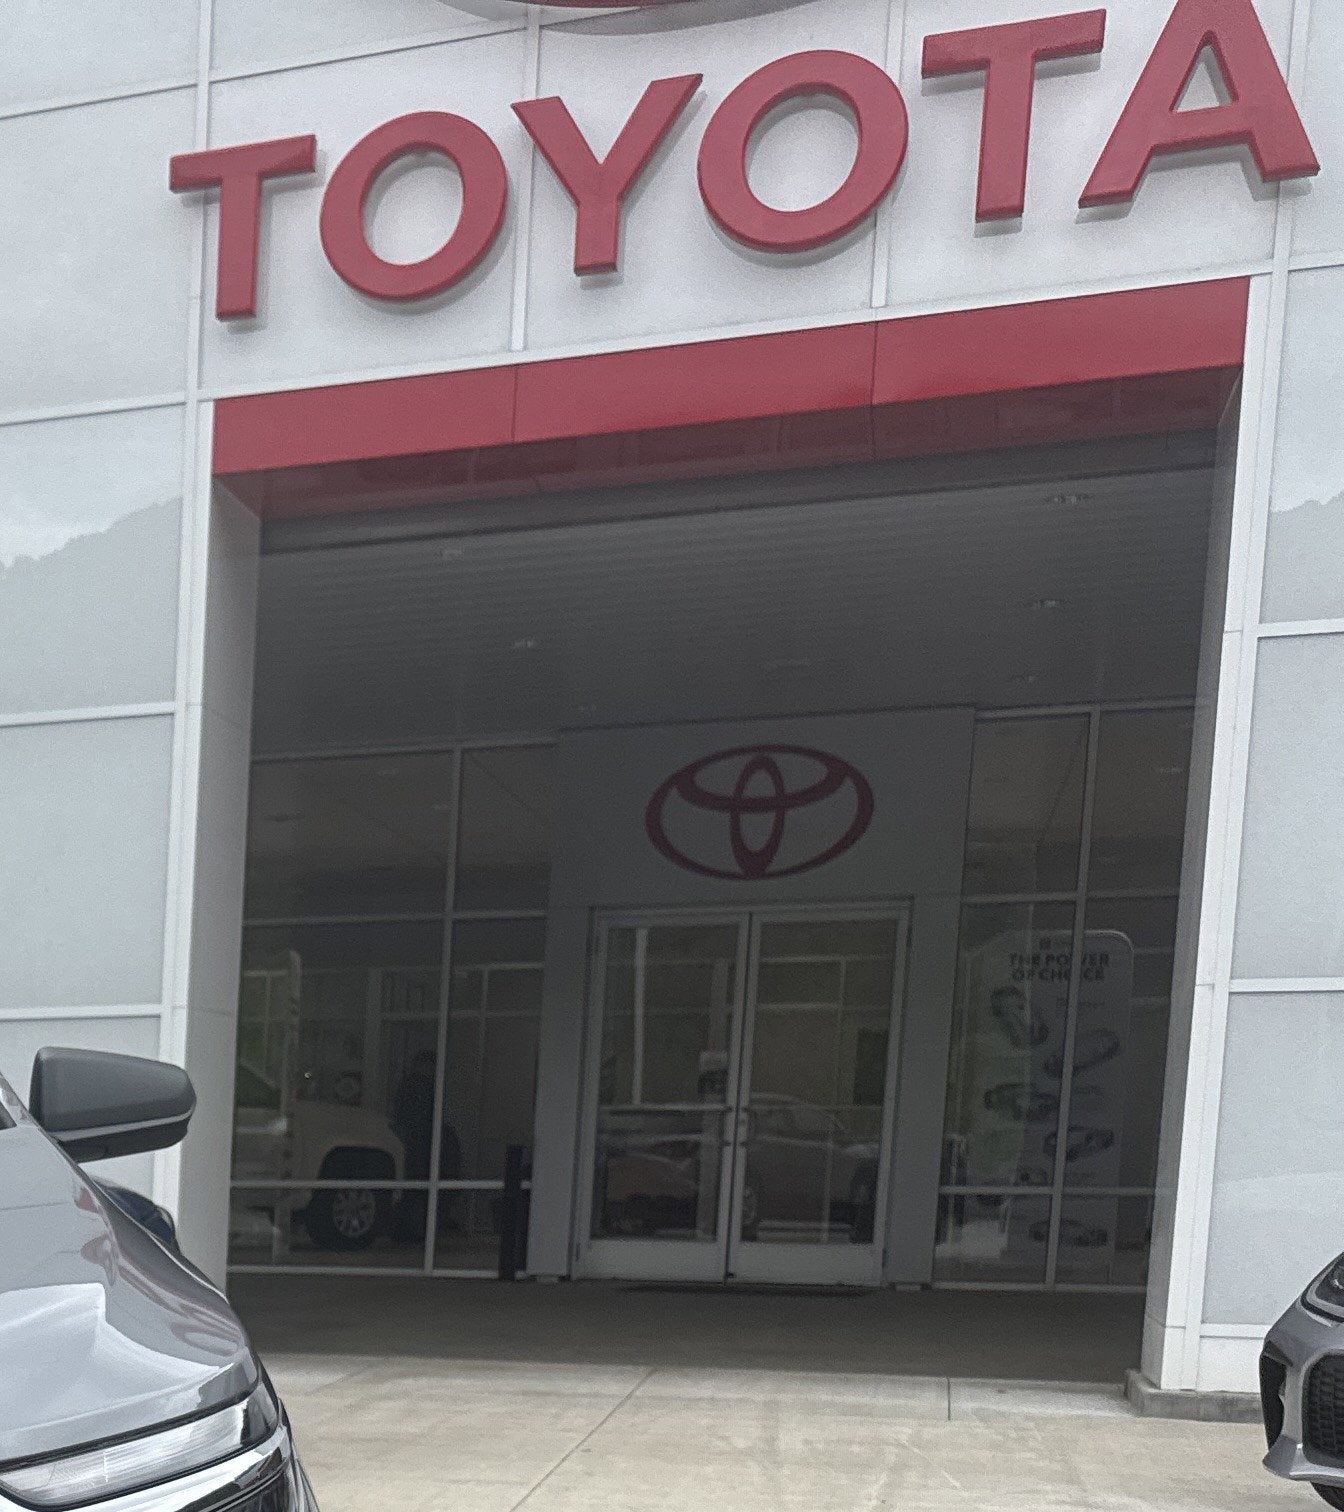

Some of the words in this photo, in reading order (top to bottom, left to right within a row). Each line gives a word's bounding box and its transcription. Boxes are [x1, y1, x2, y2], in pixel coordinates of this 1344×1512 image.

[167, 0, 1322, 321] TOYOTA
[1045, 953, 1110, 967] POER
[1038, 967, 1105, 981] CHOCE
